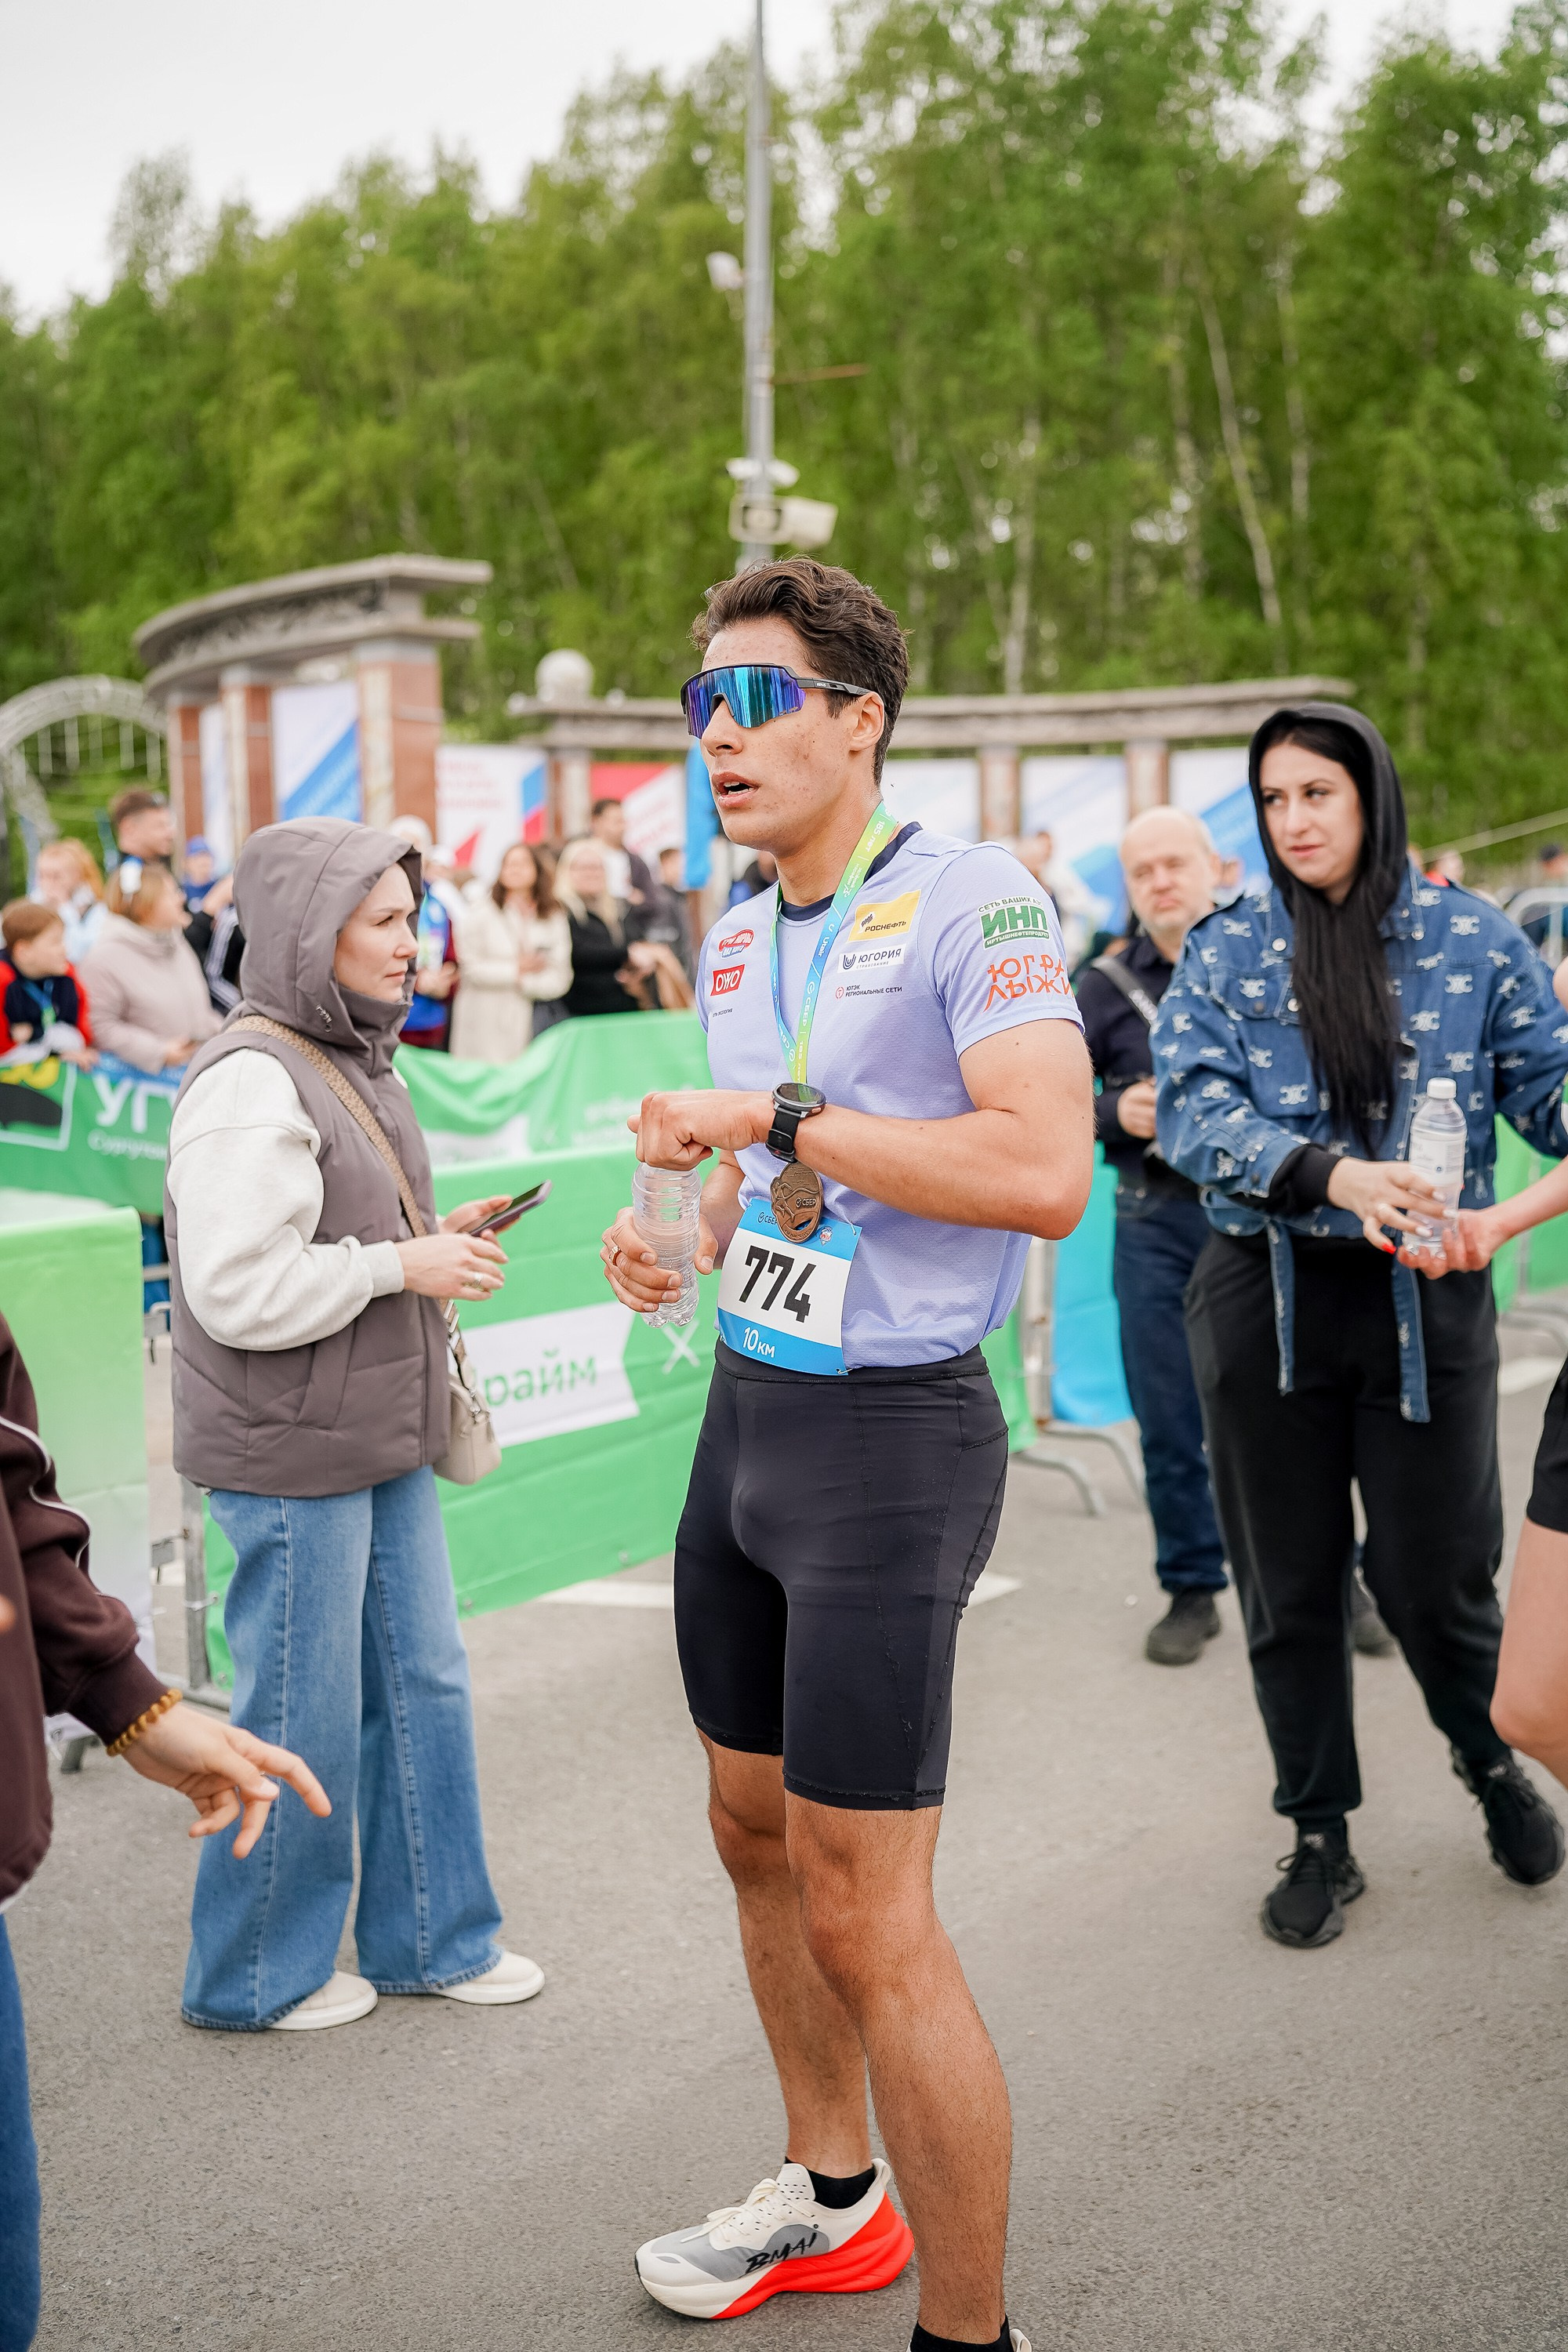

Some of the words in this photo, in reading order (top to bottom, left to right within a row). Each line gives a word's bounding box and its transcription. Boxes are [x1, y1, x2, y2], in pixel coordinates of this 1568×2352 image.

[873, 820, 885, 836] 185
[865, 836, 877, 852] лет
[978, 900, 1001, 913] СЕТЬ
[1001, 896, 1030, 906] ВАШИХ
[864, 920, 907, 933] РОСНЕФТЬ
[981, 905, 1048, 939] ИНП
[858, 948, 902, 964] ЮГОРИЯ
[987, 954, 1065, 983] ЮГРА
[845, 988, 884, 997] РЕГИОНАЛЬНЫЕ
[982, 975, 1075, 1013] ЛЫЖИ
[802, 996, 811, 1027] СБЕР
[801, 1198, 817, 1207] СБЕР
[739, 1245, 817, 1323] 774
[472, 1347, 597, 1407] райм
